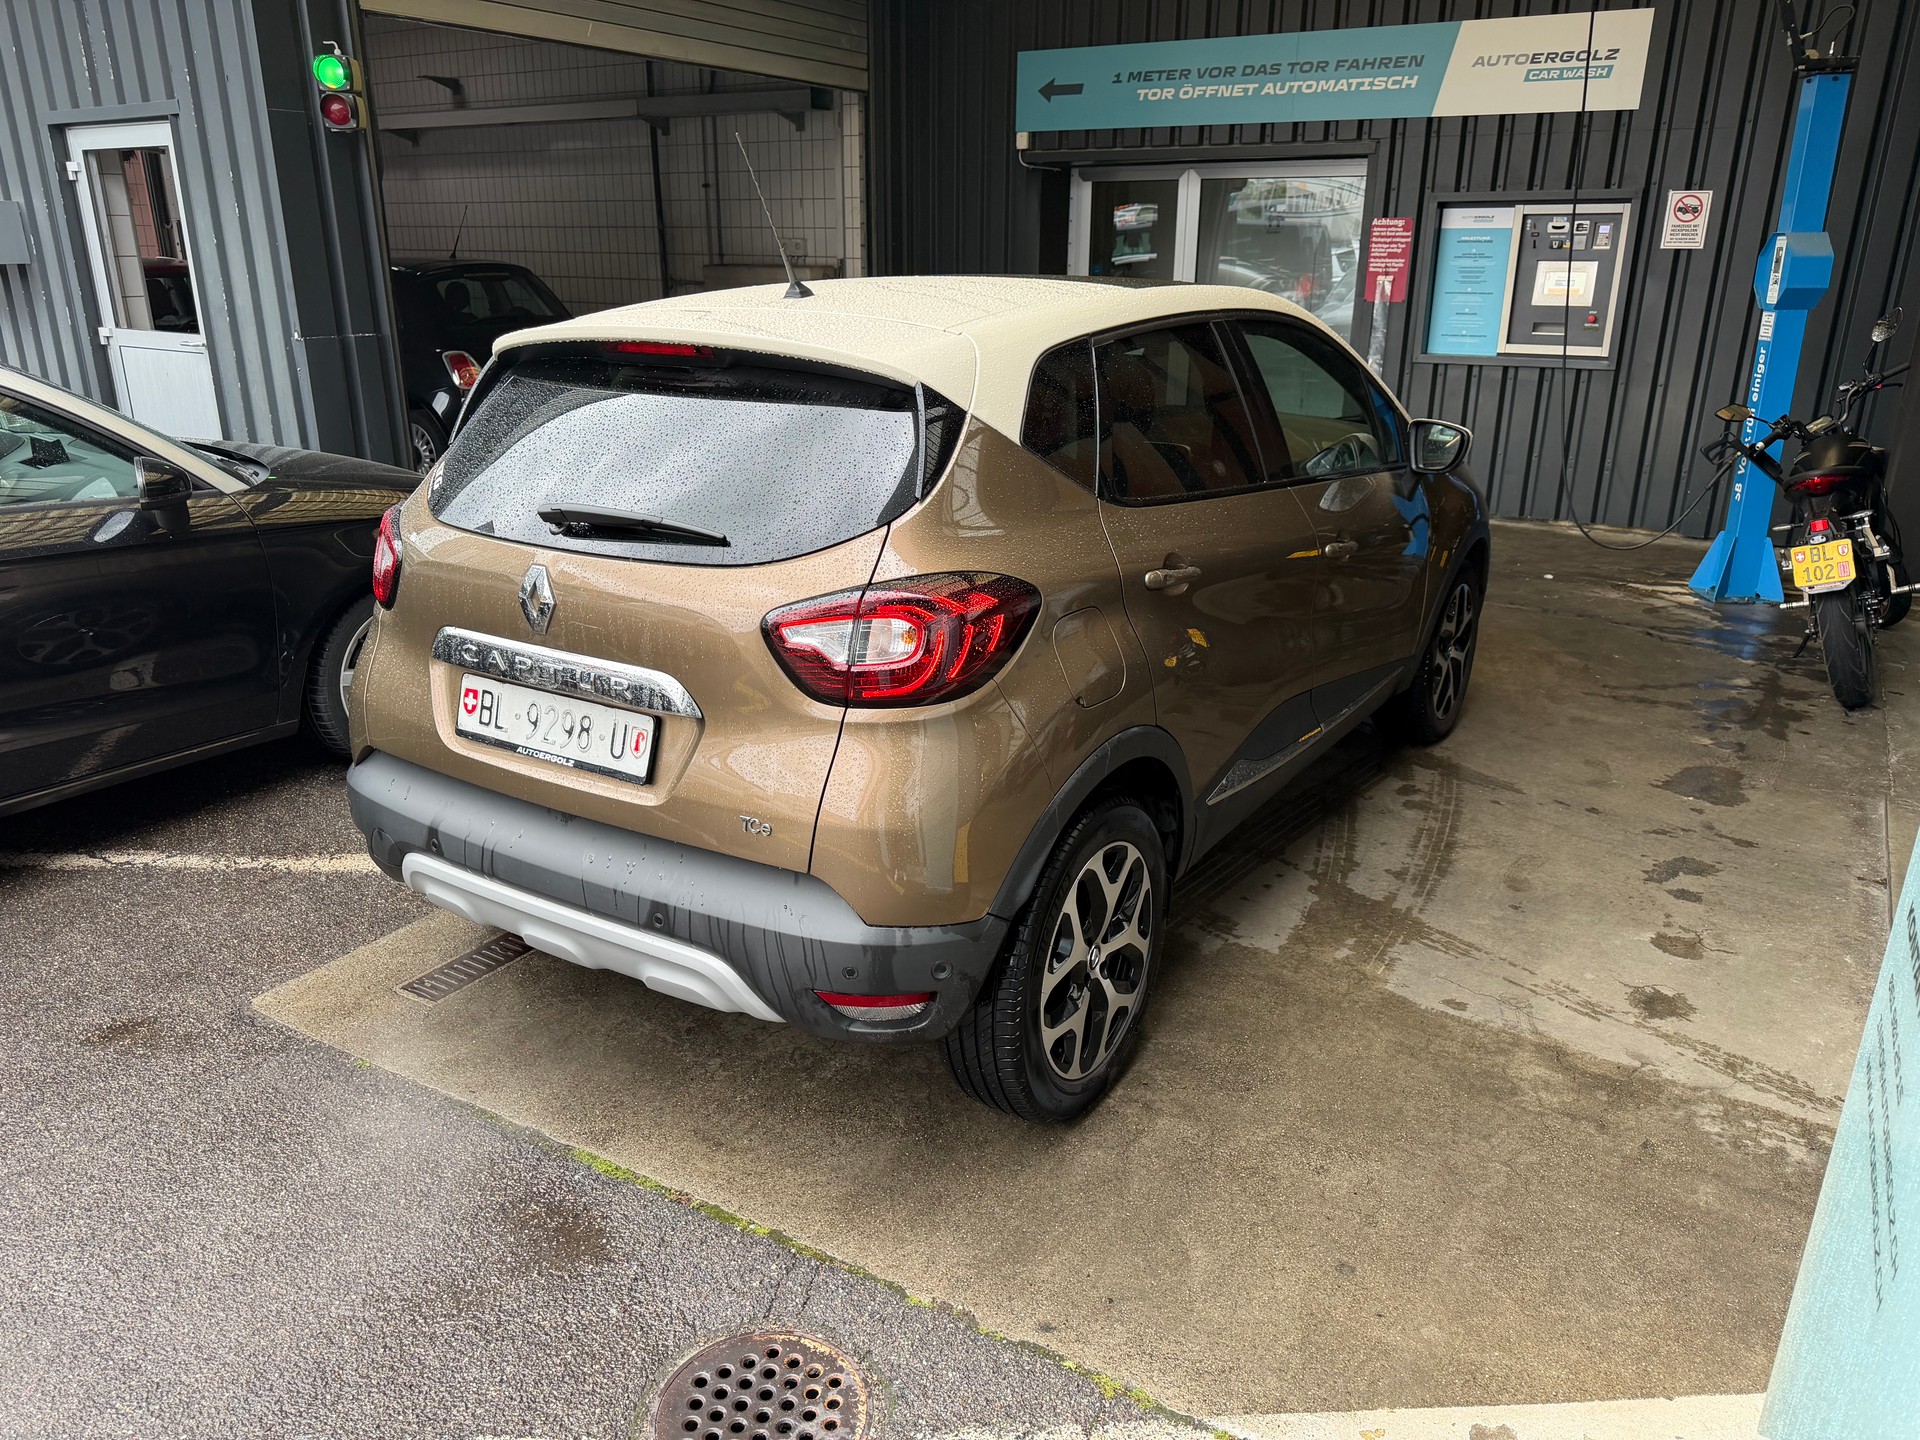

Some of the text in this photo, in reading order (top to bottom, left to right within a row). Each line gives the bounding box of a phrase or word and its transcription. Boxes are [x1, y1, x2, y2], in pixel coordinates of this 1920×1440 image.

[1472, 48, 1620, 67] AUTOERGOLZ
[1111, 54, 1425, 84] 1 METER VOR DAS TOR FAHREN
[1529, 66, 1608, 80] CAR WASH
[1136, 75, 1419, 101] TOR ÖFFNET AUTOMATISCH
[1372, 218, 1406, 227] Achtung:
[1810, 545, 1833, 563] BL
[1803, 564, 1835, 583] 102
[461, 643, 632, 699] CAPTUR
[479, 689, 629, 761] BL 9298 U
[516, 746, 575, 768] AUTOERGOLZ
[739, 815, 772, 837] TCe
[1877, 1013, 1899, 1281] INFO@AUTOERGOLZ.CH
[1866, 1053, 1883, 1312] WWW.AUTOERGOLZ.CH
